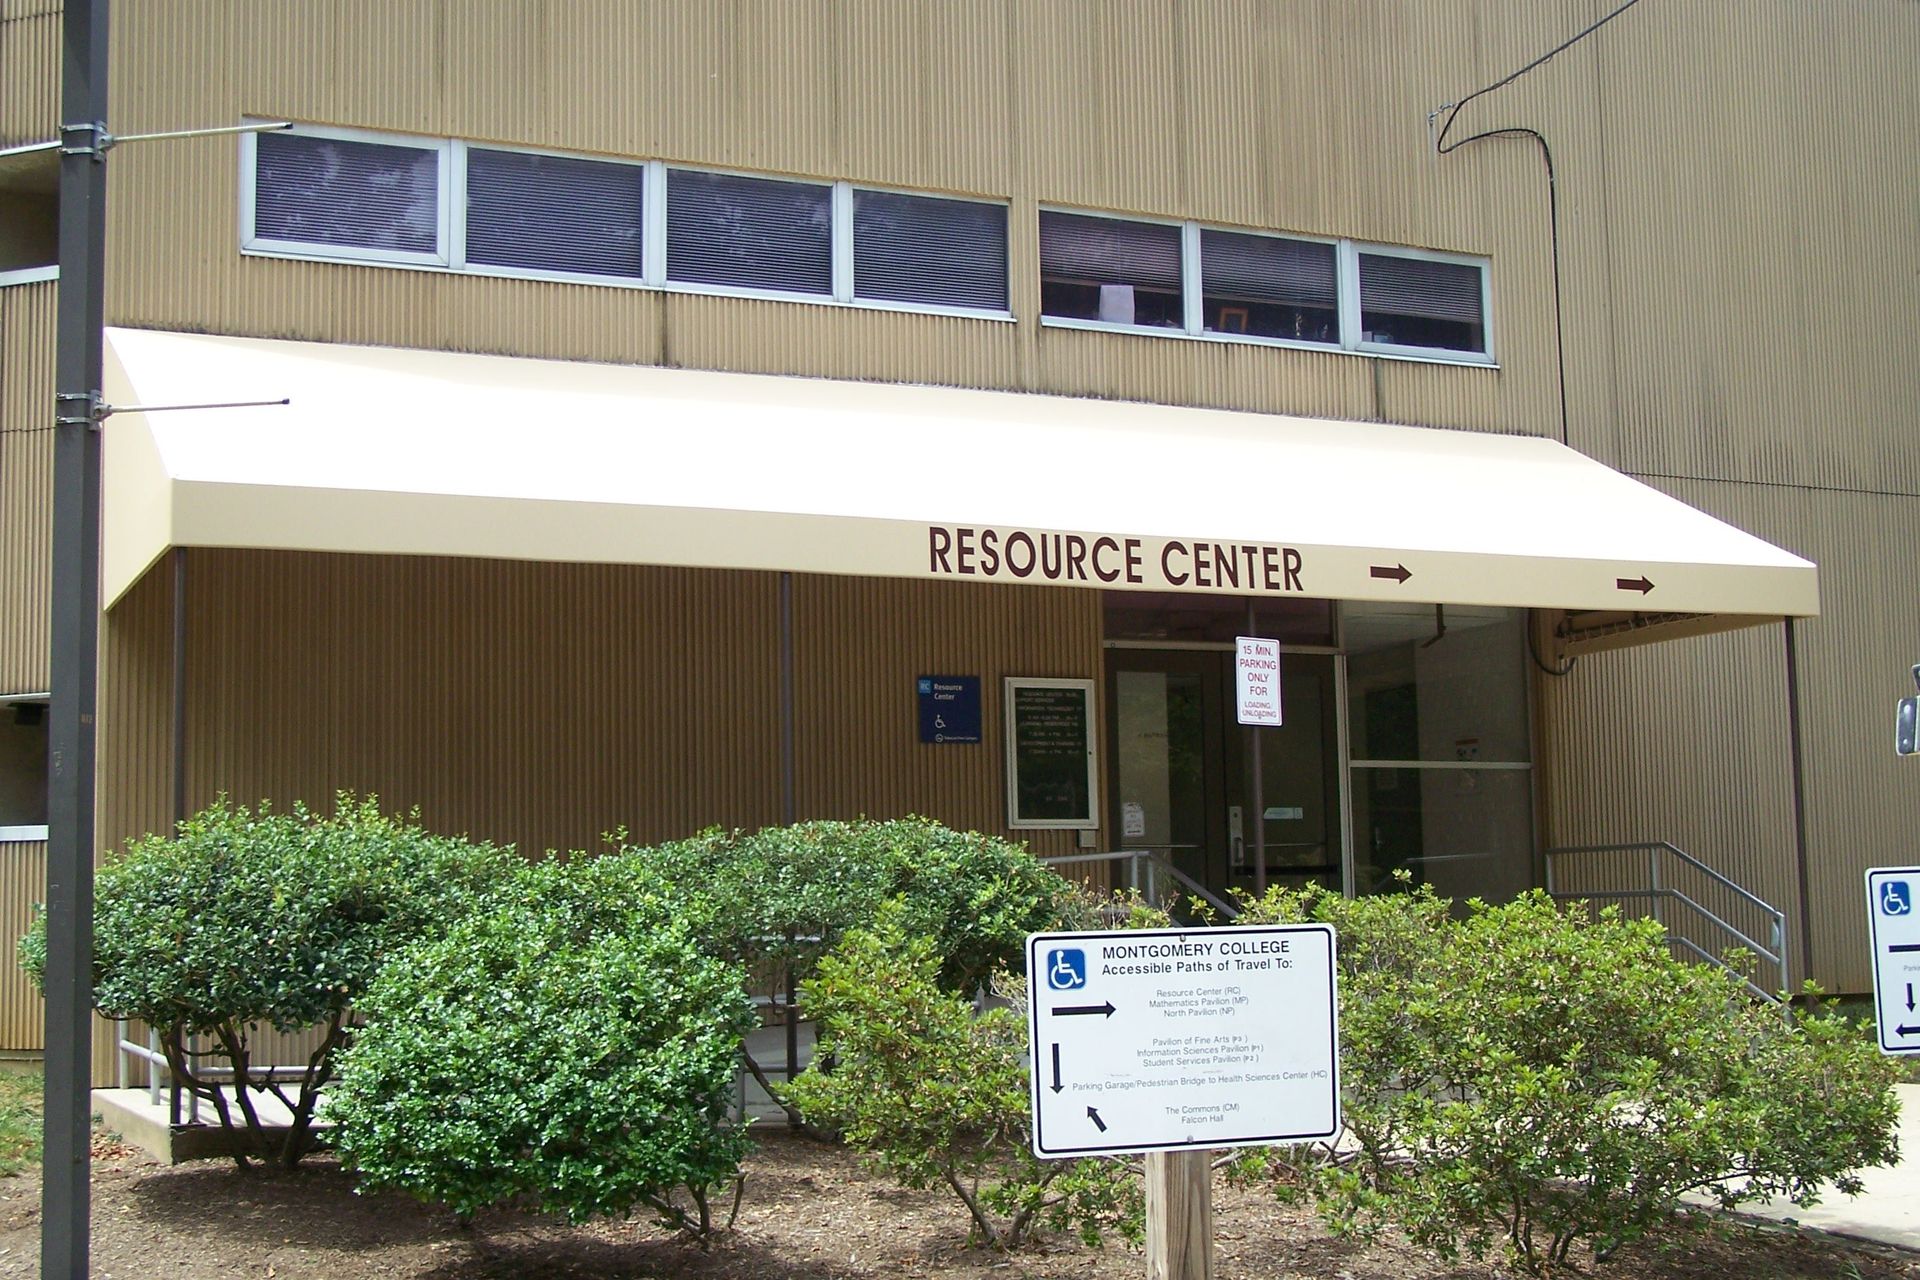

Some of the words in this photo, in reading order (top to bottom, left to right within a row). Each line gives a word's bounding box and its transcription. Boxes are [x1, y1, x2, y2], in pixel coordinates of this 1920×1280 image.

[929, 526, 1144, 583] RESOURCE
[1161, 540, 1304, 592] CENTER
[1243, 645, 1252, 654] 15
[1255, 646, 1273, 656] MIN.
[1239, 658, 1277, 670] PARKING
[1247, 672, 1269, 682] ONLY
[934, 683, 962, 691] Resource
[1249, 686, 1268, 696] FOR
[934, 692, 955, 700] Center
[1242, 710, 1277, 718] UNLOADING
[1102, 943, 1213, 959] MONTGOMERY
[1219, 941, 1290, 955] COLLEGE
[1102, 963, 1172, 975] Accessible
[1177, 961, 1213, 973] Paths
[1217, 960, 1229, 971] of
[1235, 959, 1271, 970] Travel
[1275, 958, 1293, 969] To:
[1156, 989, 1194, 997] Resource
[1196, 988, 1222, 996] Center
[1224, 986, 1241, 996] (RC)
[1149, 999, 1199, 1008] Mathematics
[1201, 998, 1230, 1006] Pavilion
[1232, 997, 1249, 1006] (MP)
[1164, 1010, 1186, 1018] North
[1188, 1008, 1217, 1017] Pavilion
[1219, 1008, 1235, 1017] (NP)
[1153, 1038, 1182, 1047] Pavilion
[1195, 1037, 1211, 1045] Fine
[1213, 1036, 1230, 1044] Arts
[1137, 1048, 1181, 1057] Information
[1183, 1046, 1219, 1055] Sciences
[1221, 1045, 1249, 1053] Pavilion
[1143, 1058, 1174, 1067] Student
[1176, 1056, 1211, 1066] Services
[1213, 1055, 1241, 1063] Pavilion
[1072, 1082, 1103, 1092] Parking
[1105, 1079, 1178, 1090] Garage/Pedestrian
[1180, 1077, 1206, 1087] Bridge
[1208, 1076, 1217, 1084] to
[1218, 1075, 1243, 1083] Health
[1245, 1073, 1281, 1082] Sciences
[1282, 1071, 1309, 1080] Center
[1311, 1070, 1328, 1080] (HC)
[1166, 1106, 1180, 1115] The
[1182, 1105, 1220, 1114] Commons
[1222, 1103, 1240, 1112] (CM)
[1181, 1115, 1208, 1124] Falcon
[1209, 1114, 1224, 1123] Hall
